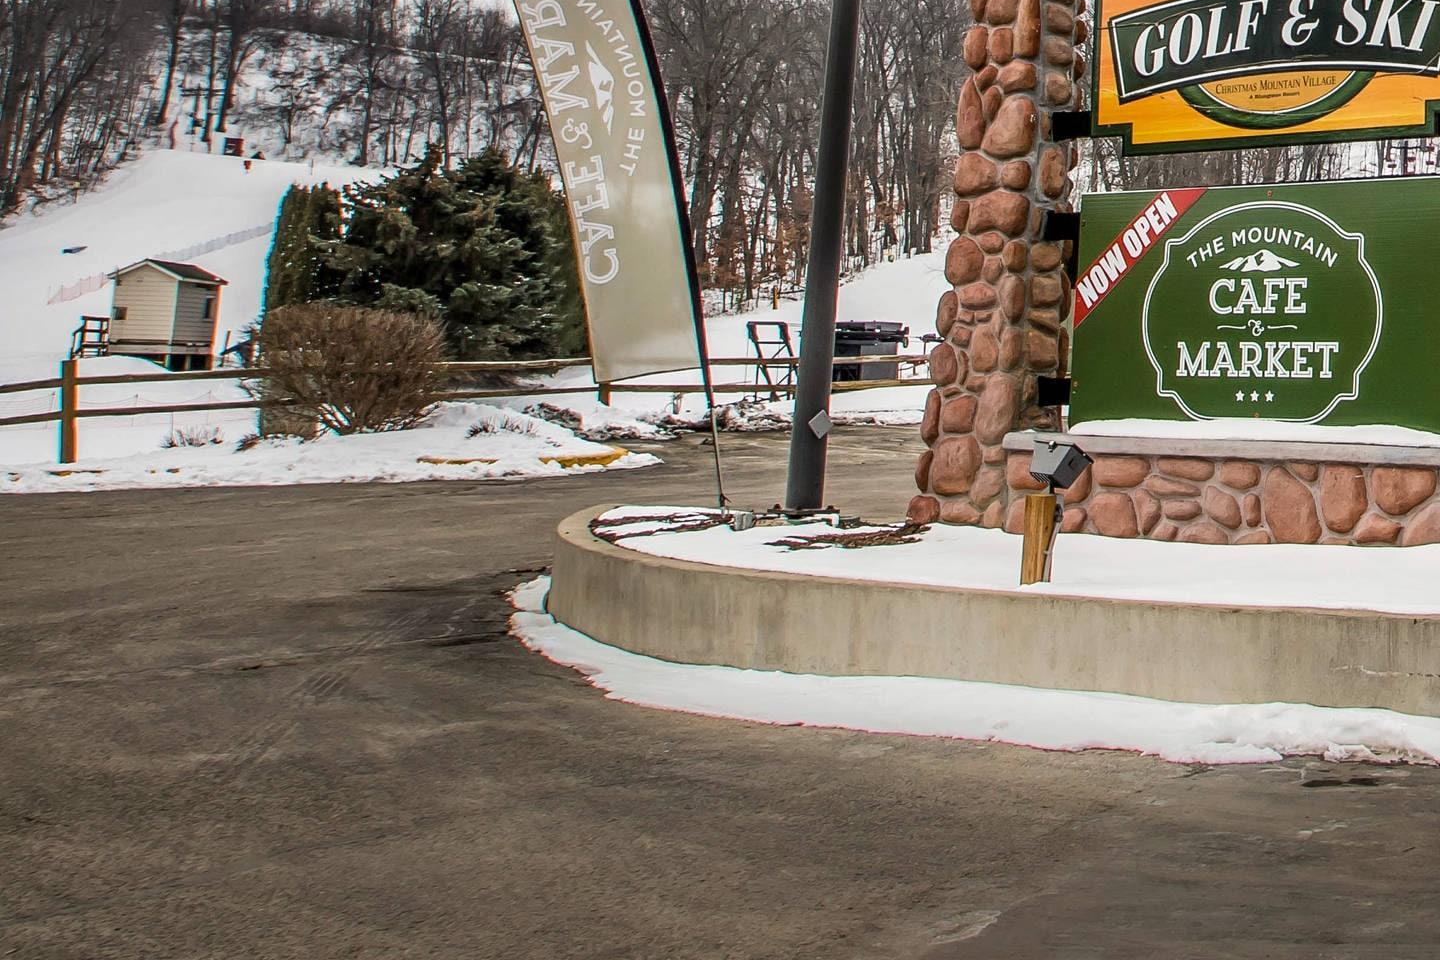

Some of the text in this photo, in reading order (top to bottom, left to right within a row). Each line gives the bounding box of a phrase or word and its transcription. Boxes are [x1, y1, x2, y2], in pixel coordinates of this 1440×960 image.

[1215, 75, 1337, 95] CHRISTMAS MOUNTAIN VILLAGE
[1076, 191, 1178, 310] NOW OPEN
[1186, 227, 1339, 269] THE MOUNTAIN
[1208, 277, 1309, 315] CAFE
[1247, 318, 1265, 337] &
[1175, 341, 1340, 379] MARKET
